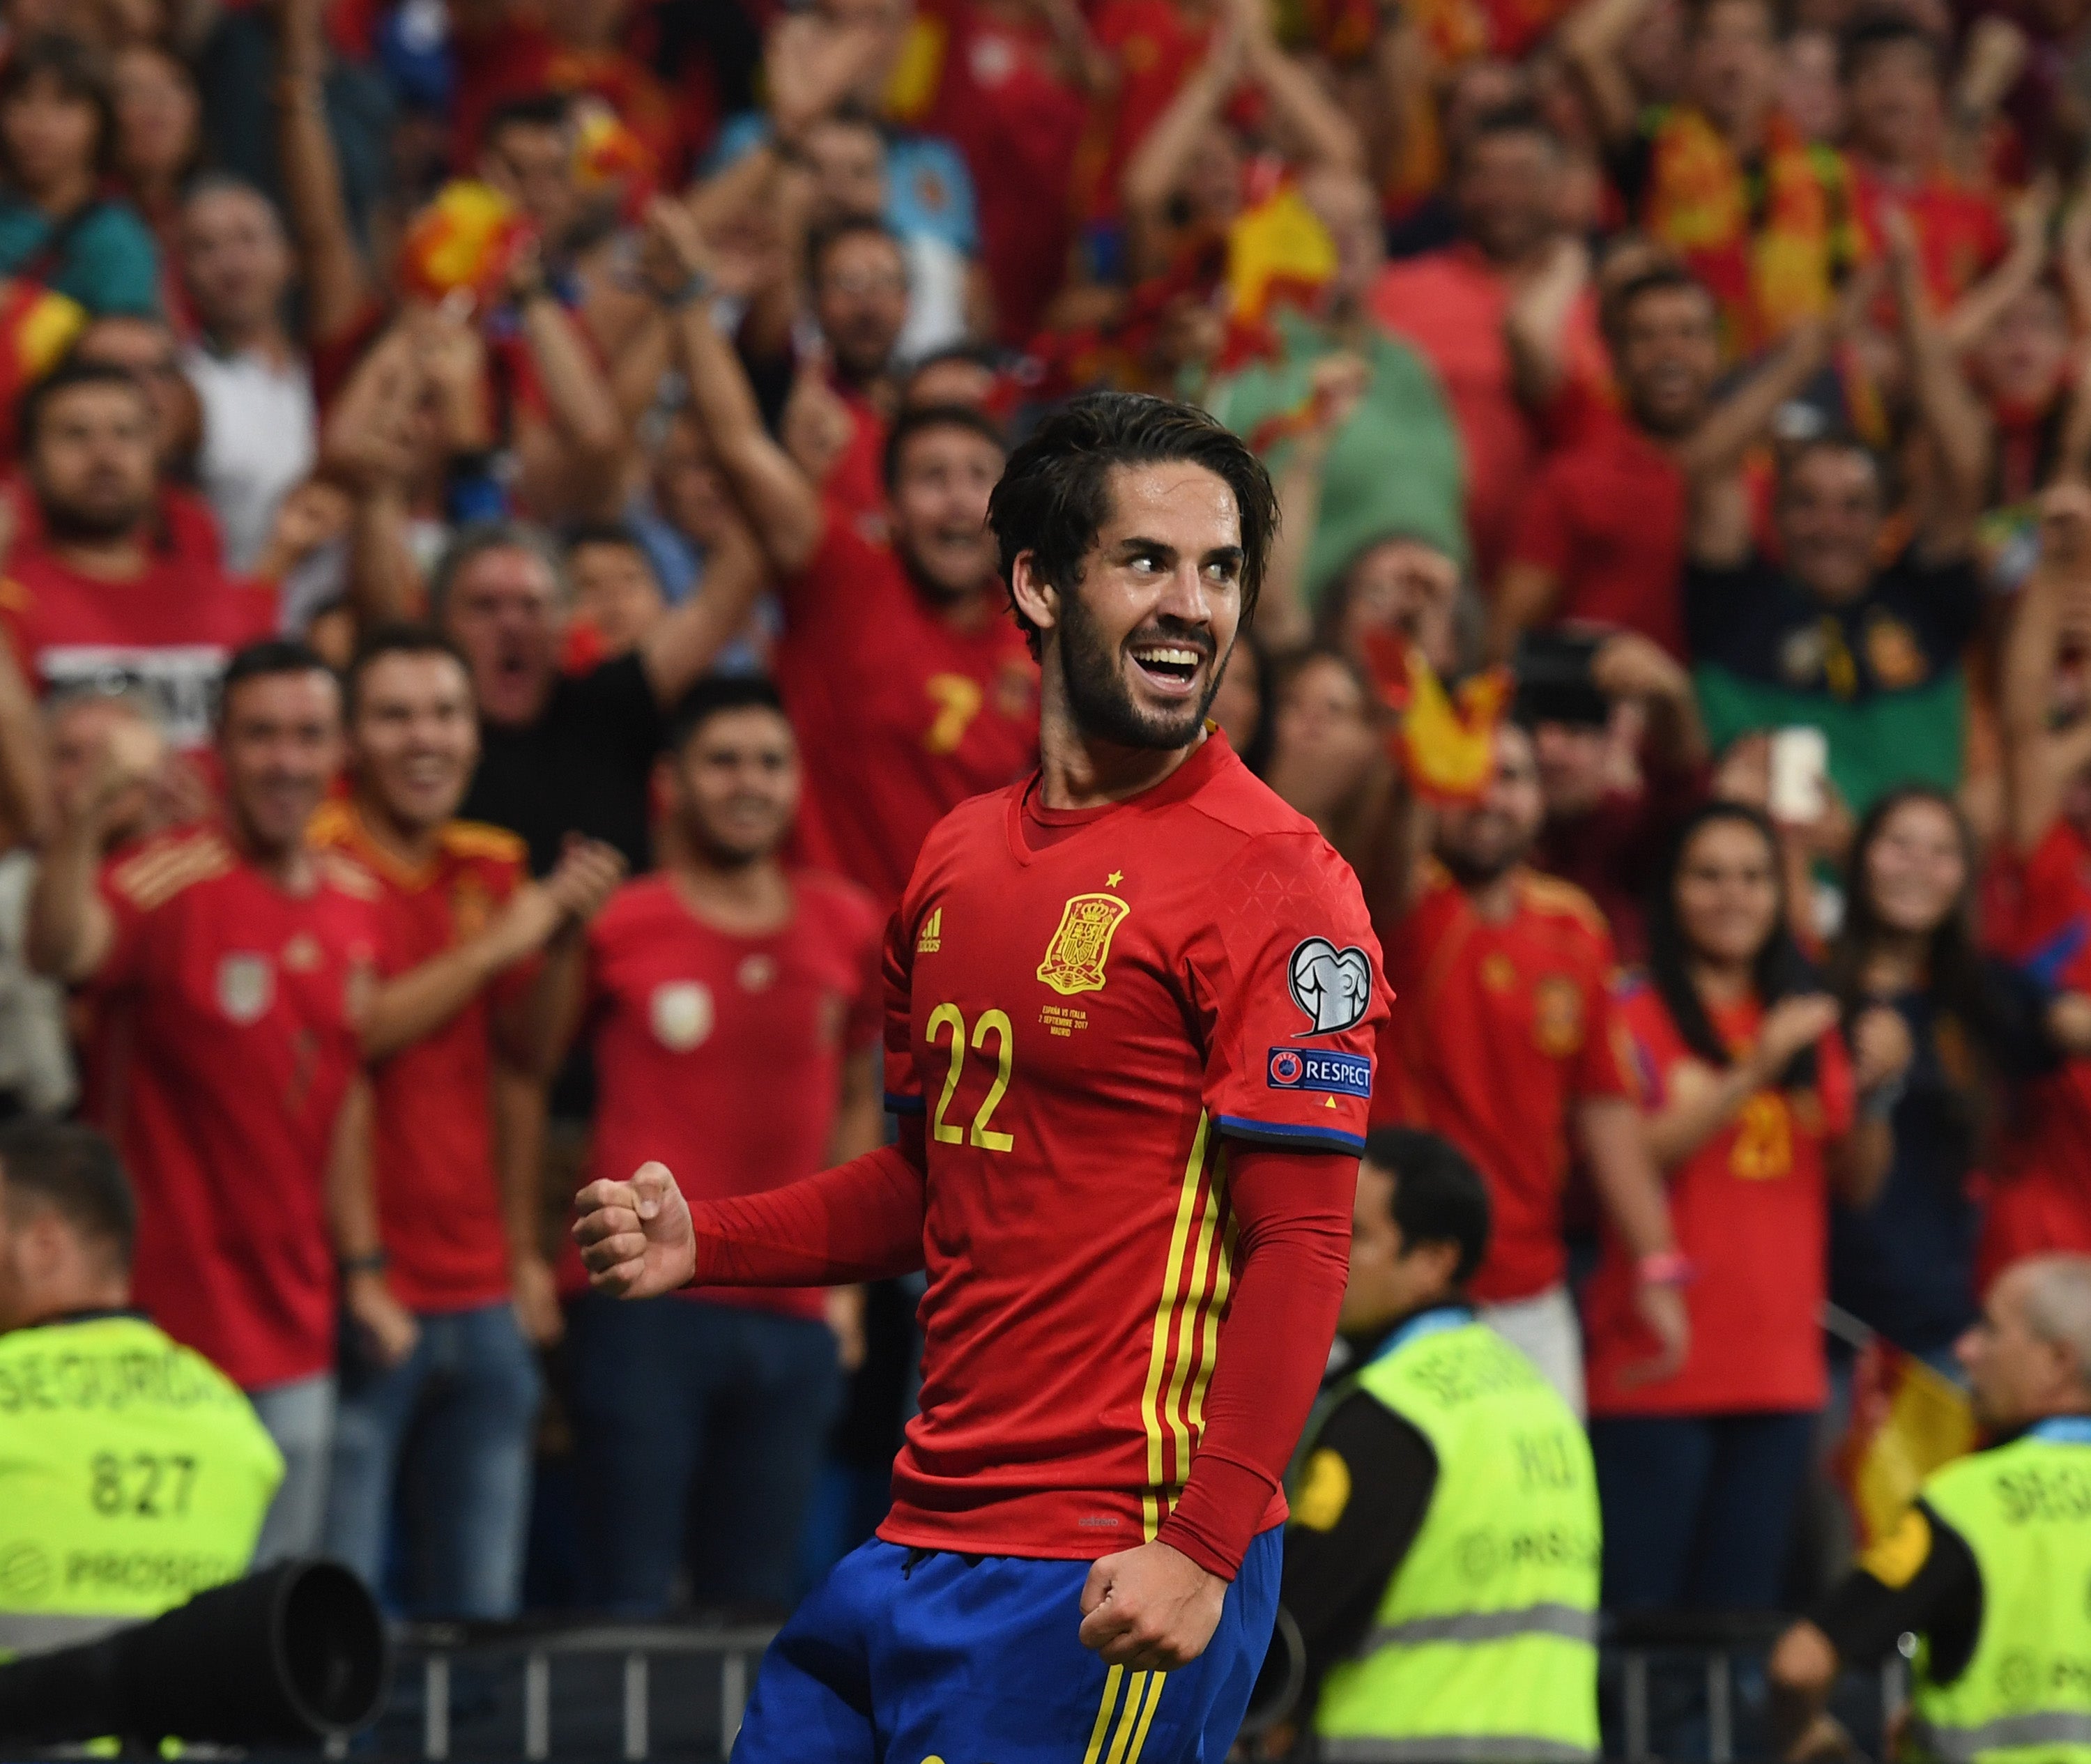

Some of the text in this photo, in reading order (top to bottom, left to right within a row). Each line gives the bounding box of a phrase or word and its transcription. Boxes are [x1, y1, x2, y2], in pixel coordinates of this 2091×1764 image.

[926, 673, 981, 755] 7
[1038, 1014, 1088, 1029] 2 SEPTIEMBRE 2017
[1062, 1008, 1069, 1017] VS
[1069, 1009, 1086, 1020] ITALIA
[1050, 1026, 1071, 1037] MADRID
[1278, 1053, 1296, 1062] UEFA
[926, 1002, 1014, 1153] 22
[1306, 1060, 1370, 1087] RESPECT
[90, 1450, 201, 1519] 827
